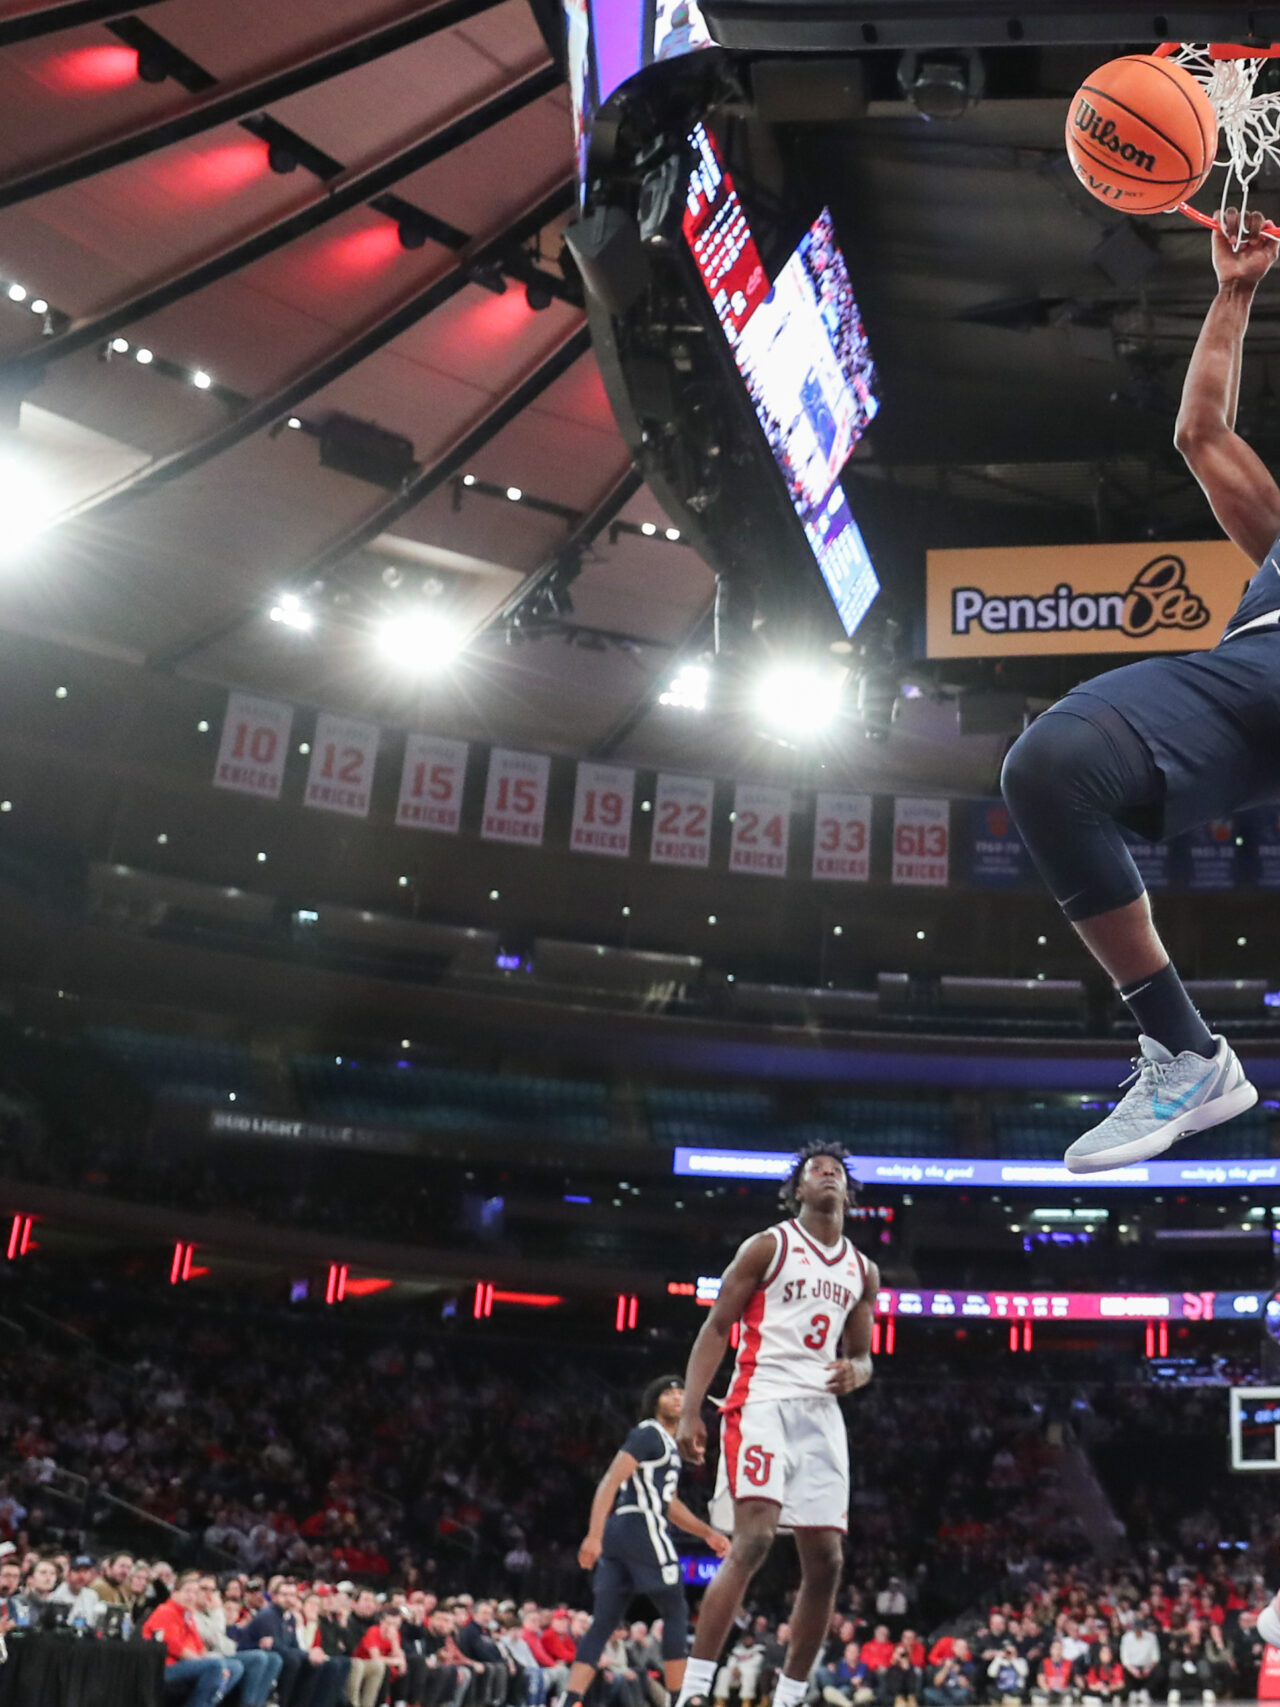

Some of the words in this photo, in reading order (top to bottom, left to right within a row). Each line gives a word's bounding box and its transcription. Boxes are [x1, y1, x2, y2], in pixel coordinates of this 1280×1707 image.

[1074, 98, 1156, 173] Wilson
[232, 723, 277, 764] 10
[220, 763, 277, 791] KNICKS
[321, 743, 365, 784] 12
[309, 784, 367, 810] KNICKS
[411, 762, 455, 802] 15
[496, 777, 537, 815] 15
[401, 801, 457, 826] KNICKS
[583, 791, 623, 826] 19
[658, 802, 706, 839] 22
[485, 816, 539, 838] KNICKS
[575, 826, 627, 852] KNICKS
[736, 811, 783, 847] 24
[819, 819, 865, 853] 33
[895, 824, 946, 857] 613
[654, 840, 706, 866] KNICKS
[734, 849, 783, 873] KNICKS
[817, 856, 866, 877] KNICKS
[896, 860, 946, 881] KNICKS
[252, 1117, 302, 1137] LIGHT
[782, 1279, 807, 1303] ST.
[811, 1278, 858, 1311] JOHN
[803, 1313, 831, 1351] 3
